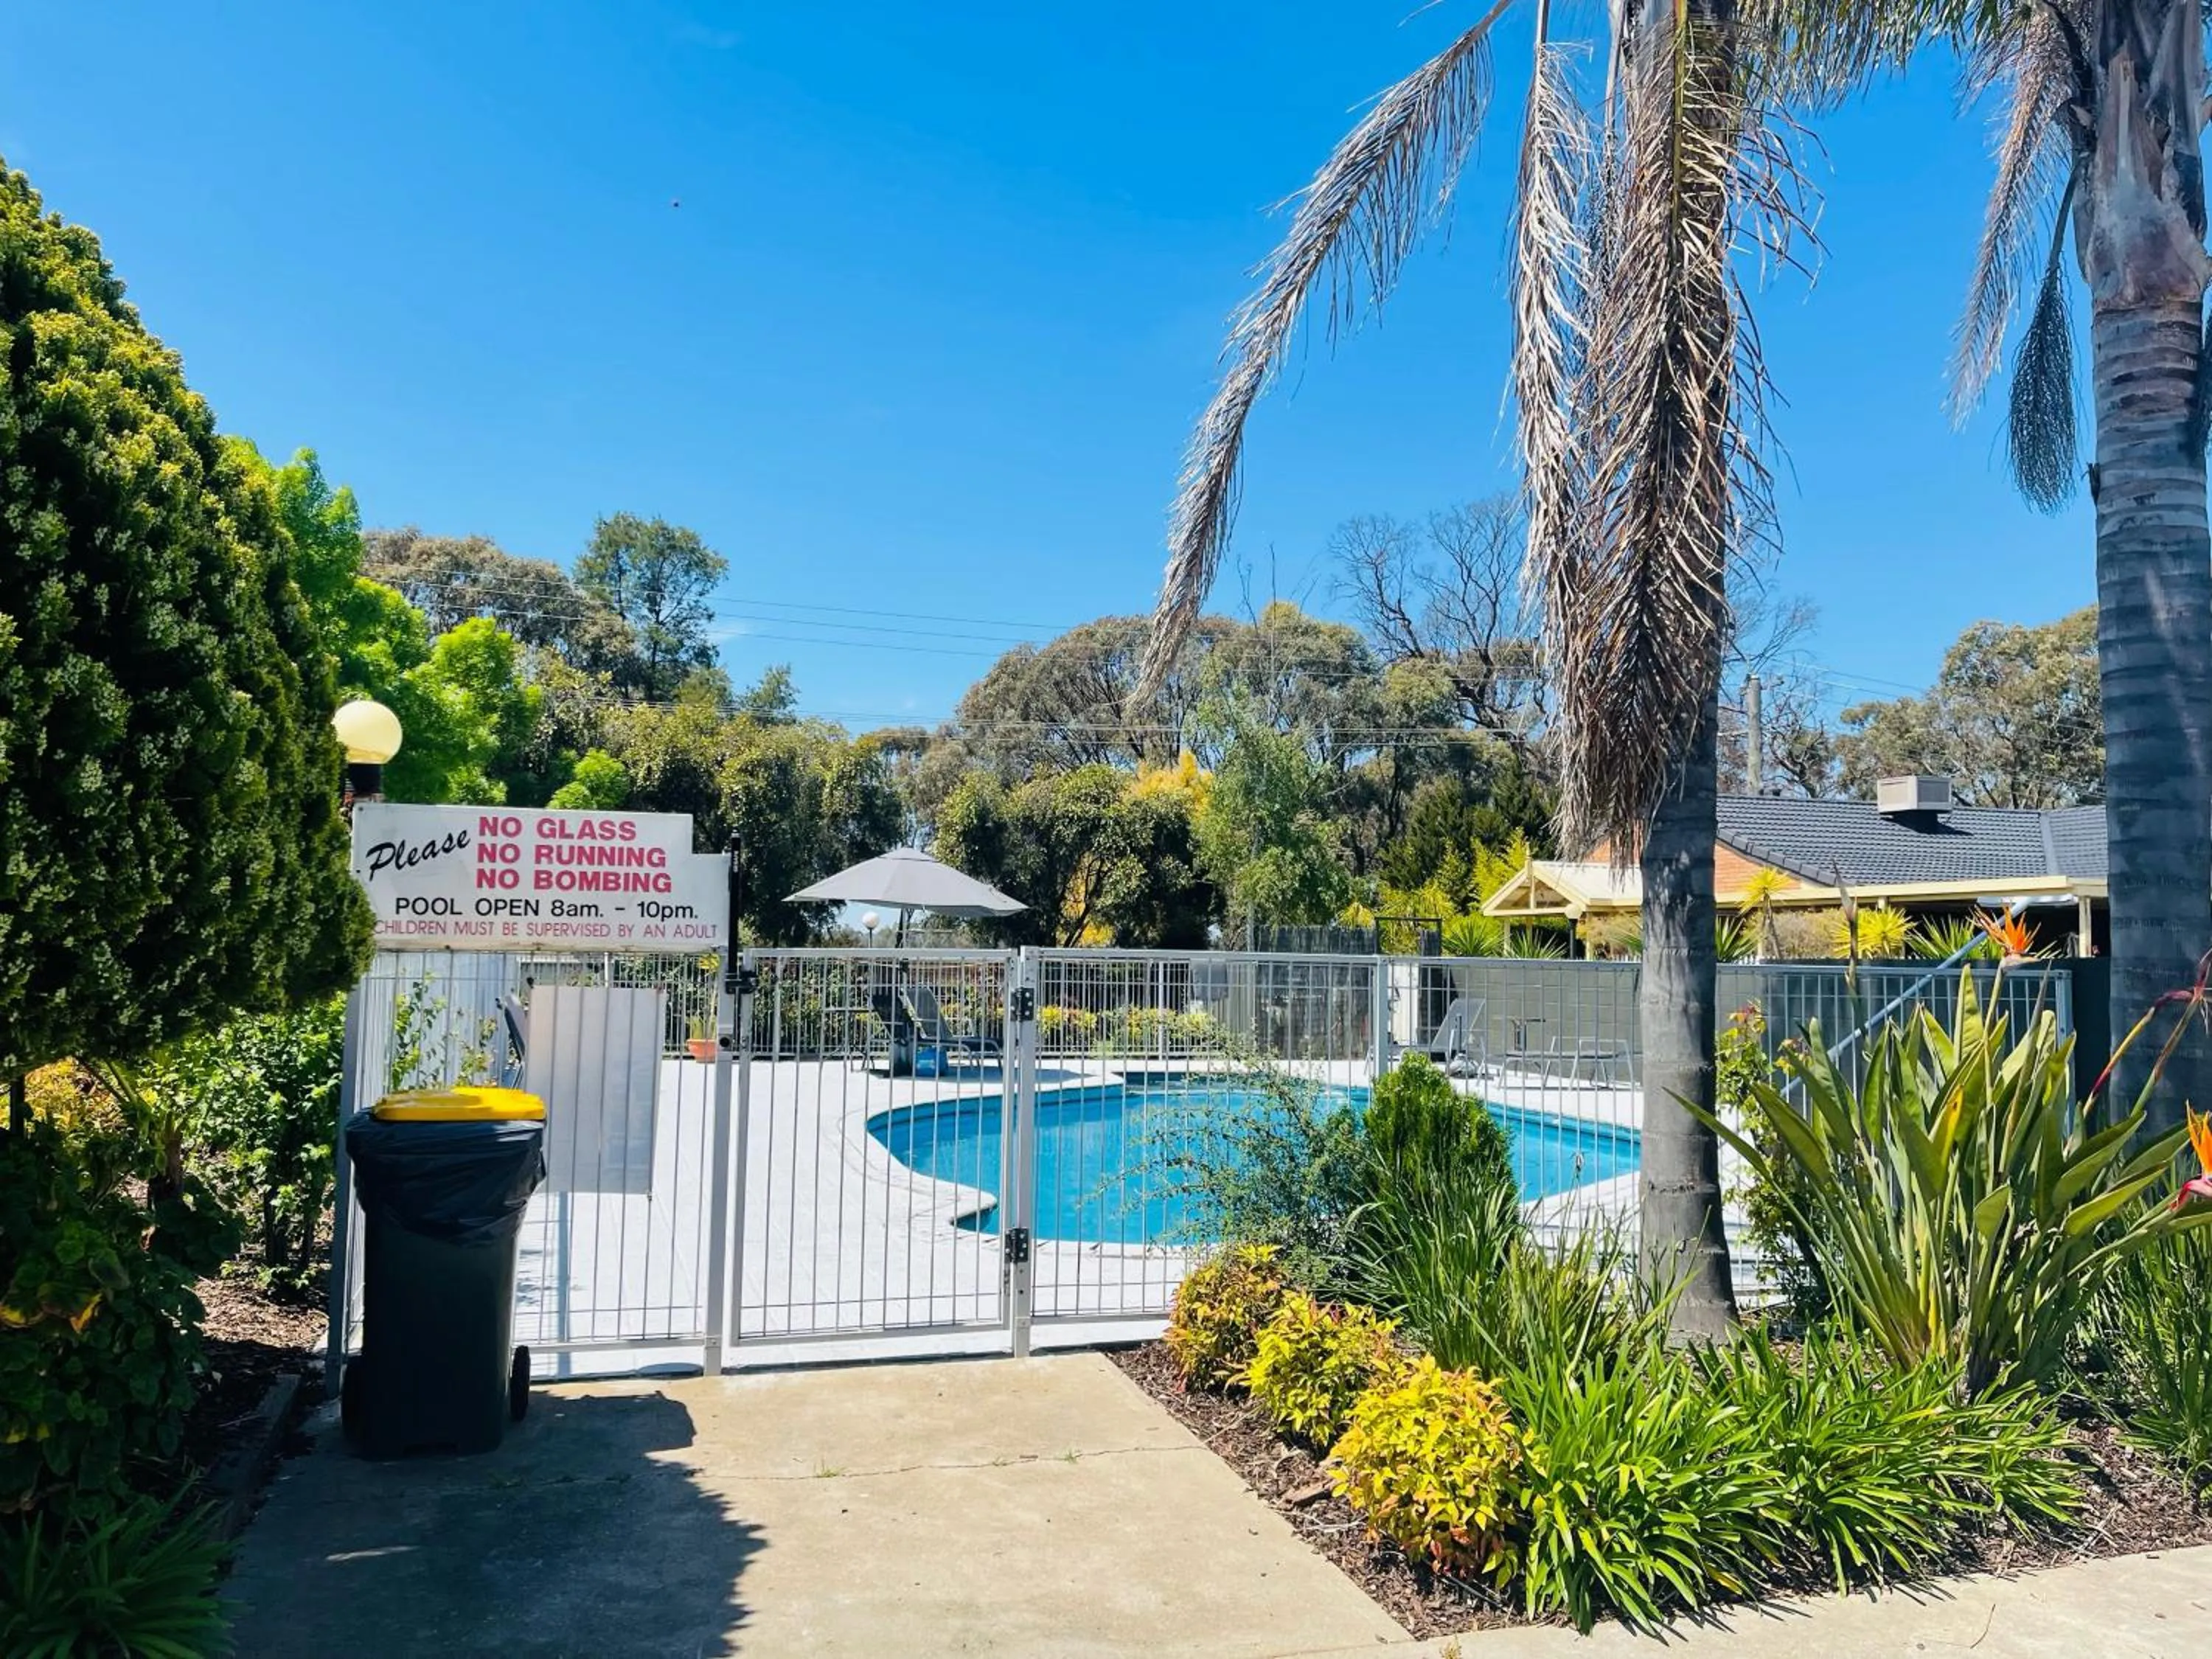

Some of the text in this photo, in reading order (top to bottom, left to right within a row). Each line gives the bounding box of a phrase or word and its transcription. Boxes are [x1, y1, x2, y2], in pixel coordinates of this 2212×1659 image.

[479, 816, 636, 842] NO GLASS
[366, 830, 470, 881] Please
[477, 843, 667, 868] NO RUNNING
[476, 869, 672, 893] NO BOMBING
[395, 897, 462, 916] POOL
[475, 898, 540, 917] OPEN
[551, 899, 604, 919] 8am.
[637, 901, 698, 922] 10pm.
[374, 920, 717, 939] CHILDREN MUST BE SUPERVISED BY AN ADULT
